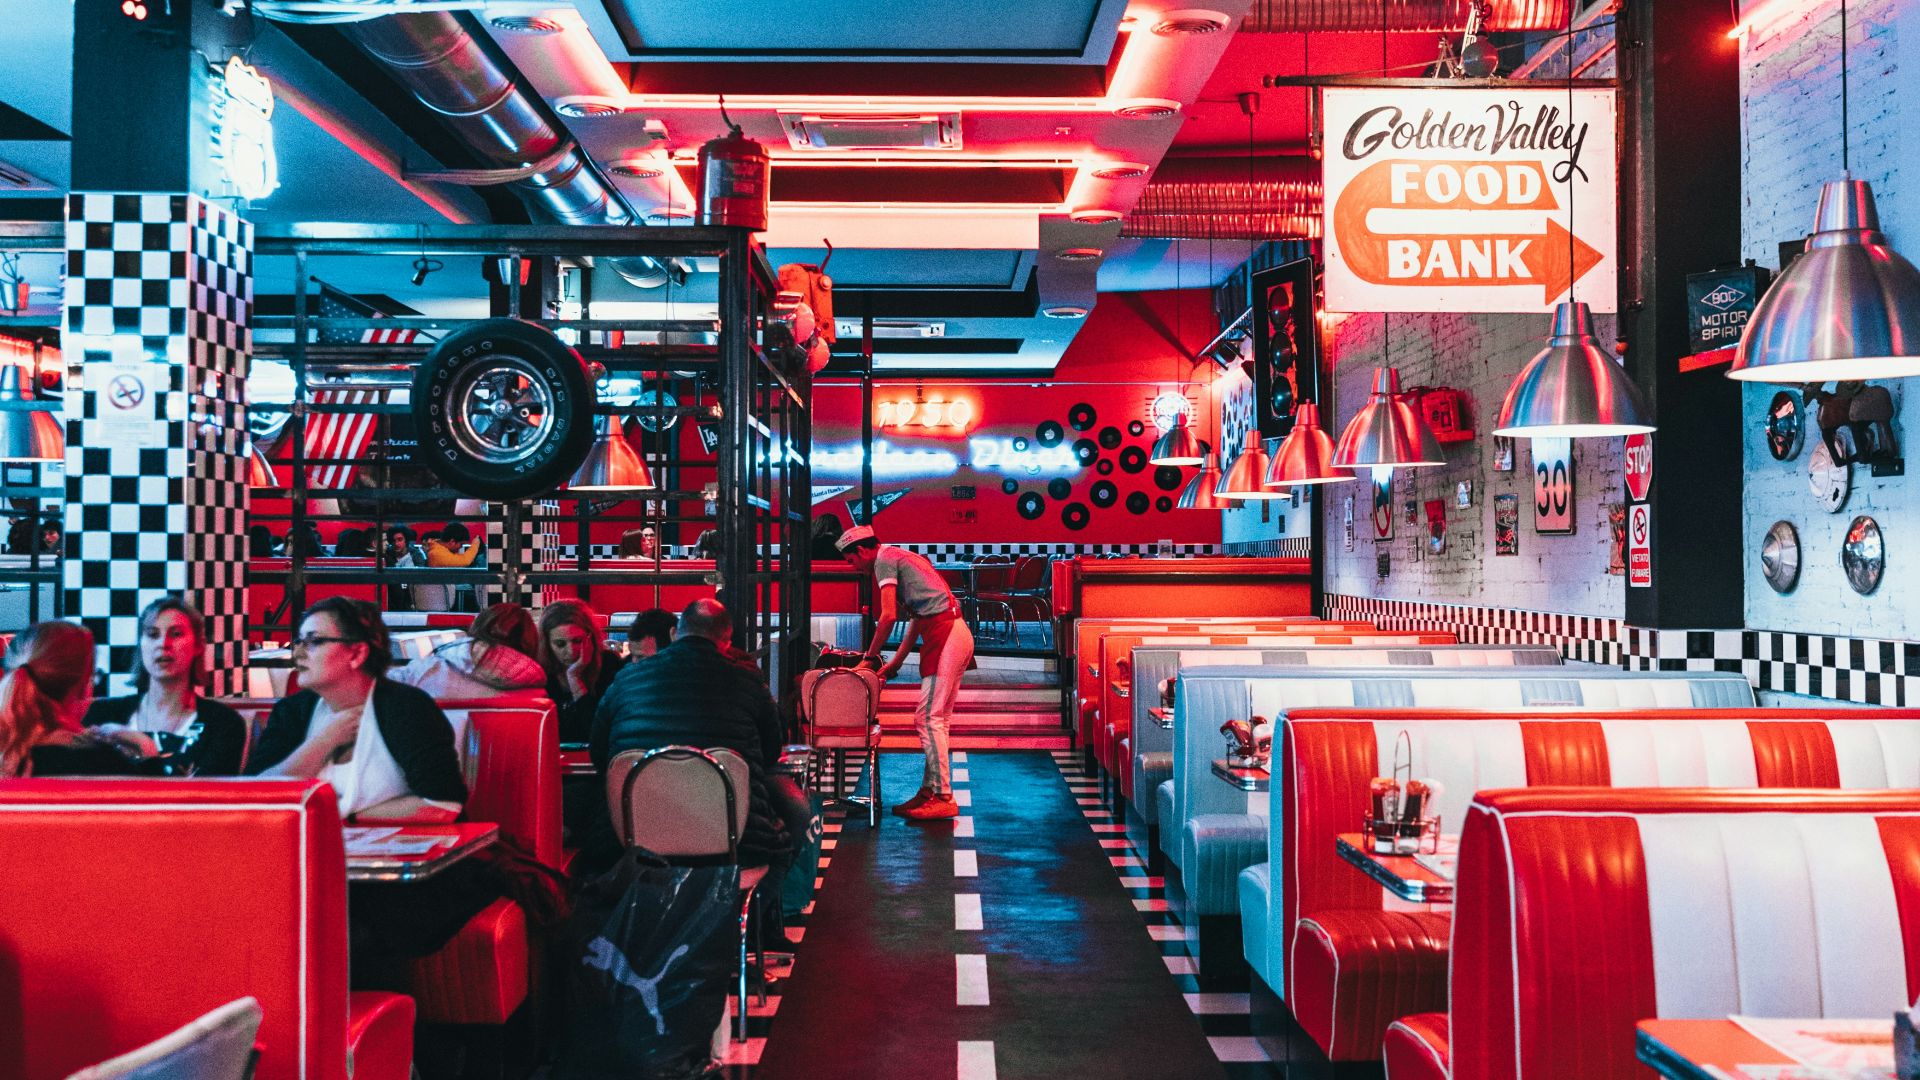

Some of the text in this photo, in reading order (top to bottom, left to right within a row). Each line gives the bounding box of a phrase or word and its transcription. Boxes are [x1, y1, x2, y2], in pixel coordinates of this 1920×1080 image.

[1343, 100, 1589, 183] Golden Valley
[1390, 163, 1542, 205] FOOD
[1387, 239, 1535, 278] BANK
[1701, 310, 1748, 327] MOTOR
[1701, 325, 1746, 341] SPIRIT
[878, 399, 972, 428] 1950
[703, 428, 718, 447] LA
[1626, 445, 1651, 476] STOP
[811, 489, 828, 499] tlanta
[1537, 459, 1567, 517] 30
